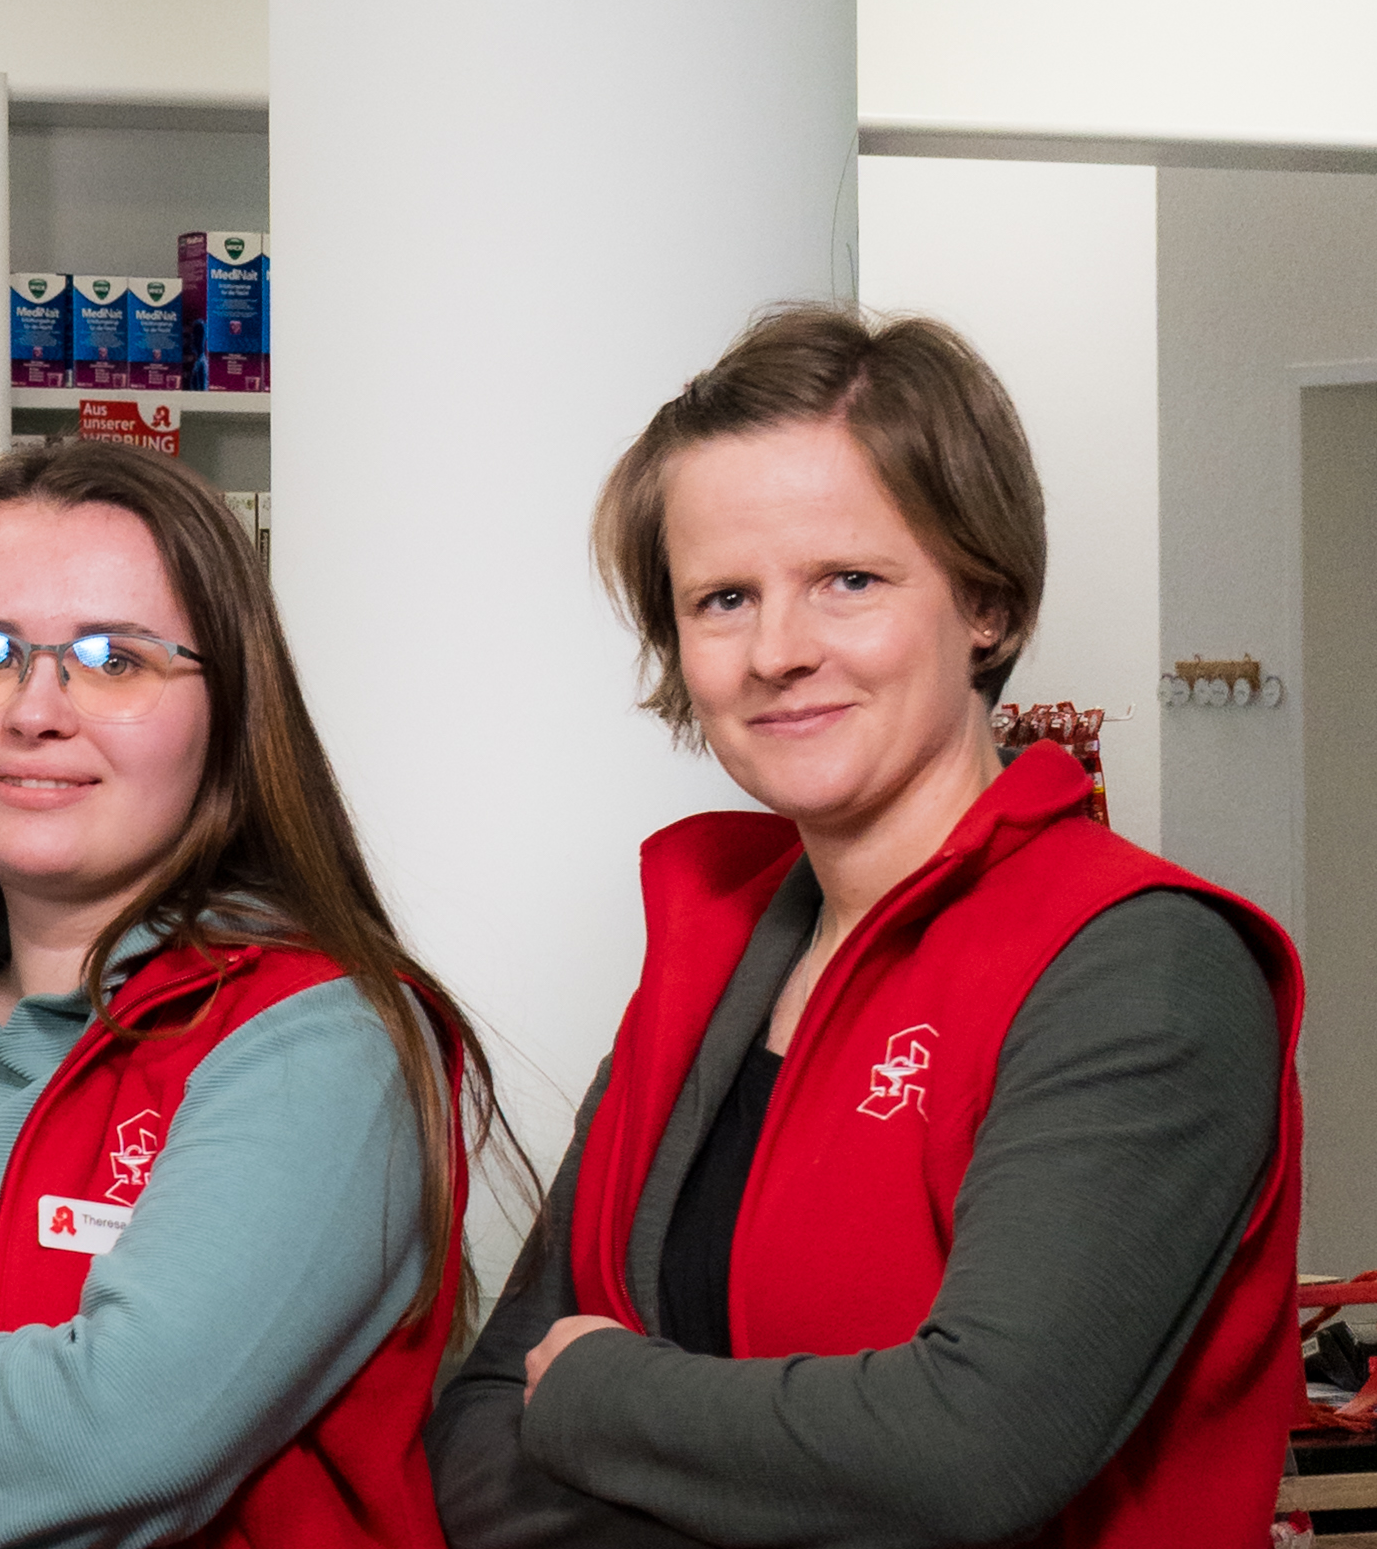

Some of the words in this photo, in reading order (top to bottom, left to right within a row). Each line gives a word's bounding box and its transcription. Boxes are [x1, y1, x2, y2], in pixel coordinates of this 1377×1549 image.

[211, 269, 258, 281] MediNait
[16, 306, 59, 318] MediNait
[82, 308, 122, 319] MediNait
[135, 310, 177, 321] MediNait
[84, 403, 107, 416] Aus
[84, 419, 135, 431] unserer
[82, 1213, 126, 1230] Theresa
